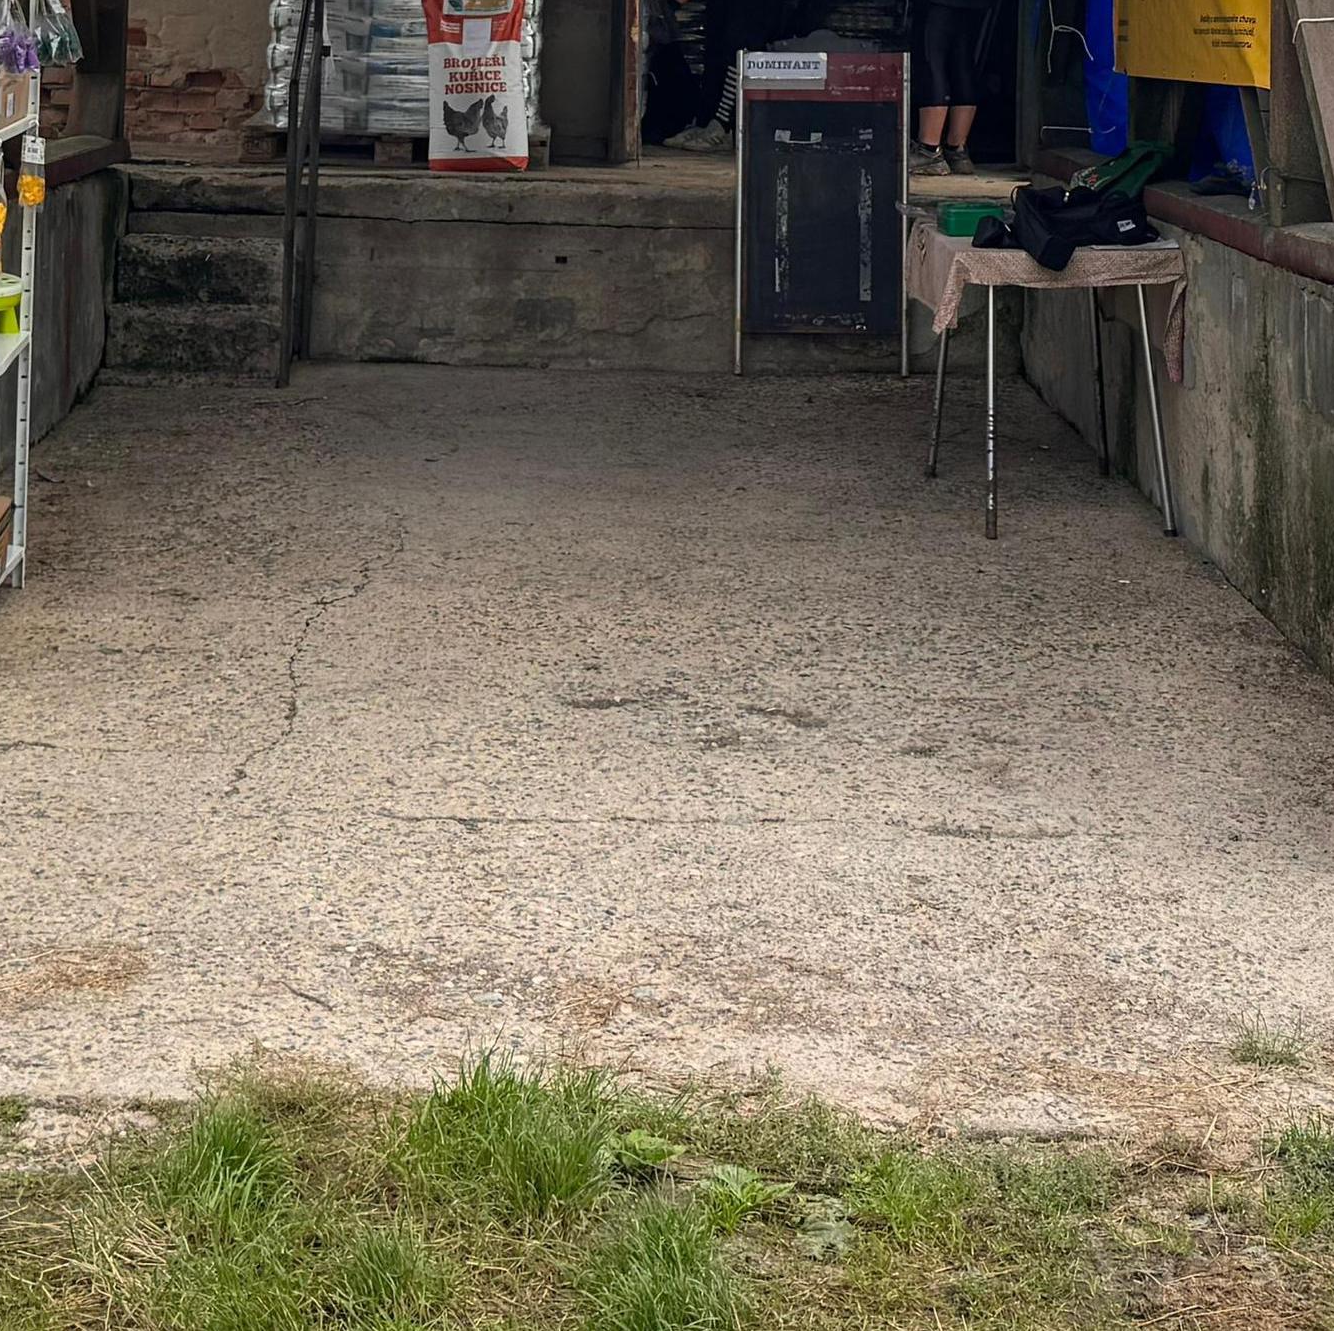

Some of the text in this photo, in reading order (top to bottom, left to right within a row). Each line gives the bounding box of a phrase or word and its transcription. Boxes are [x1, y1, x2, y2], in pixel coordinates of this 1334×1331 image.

[443, 54, 506, 69] BROJLEŘI
[747, 60, 821, 70] DOMINANT
[449, 70, 501, 82] KUŘICE
[445, 82, 507, 94] NOSNICE
